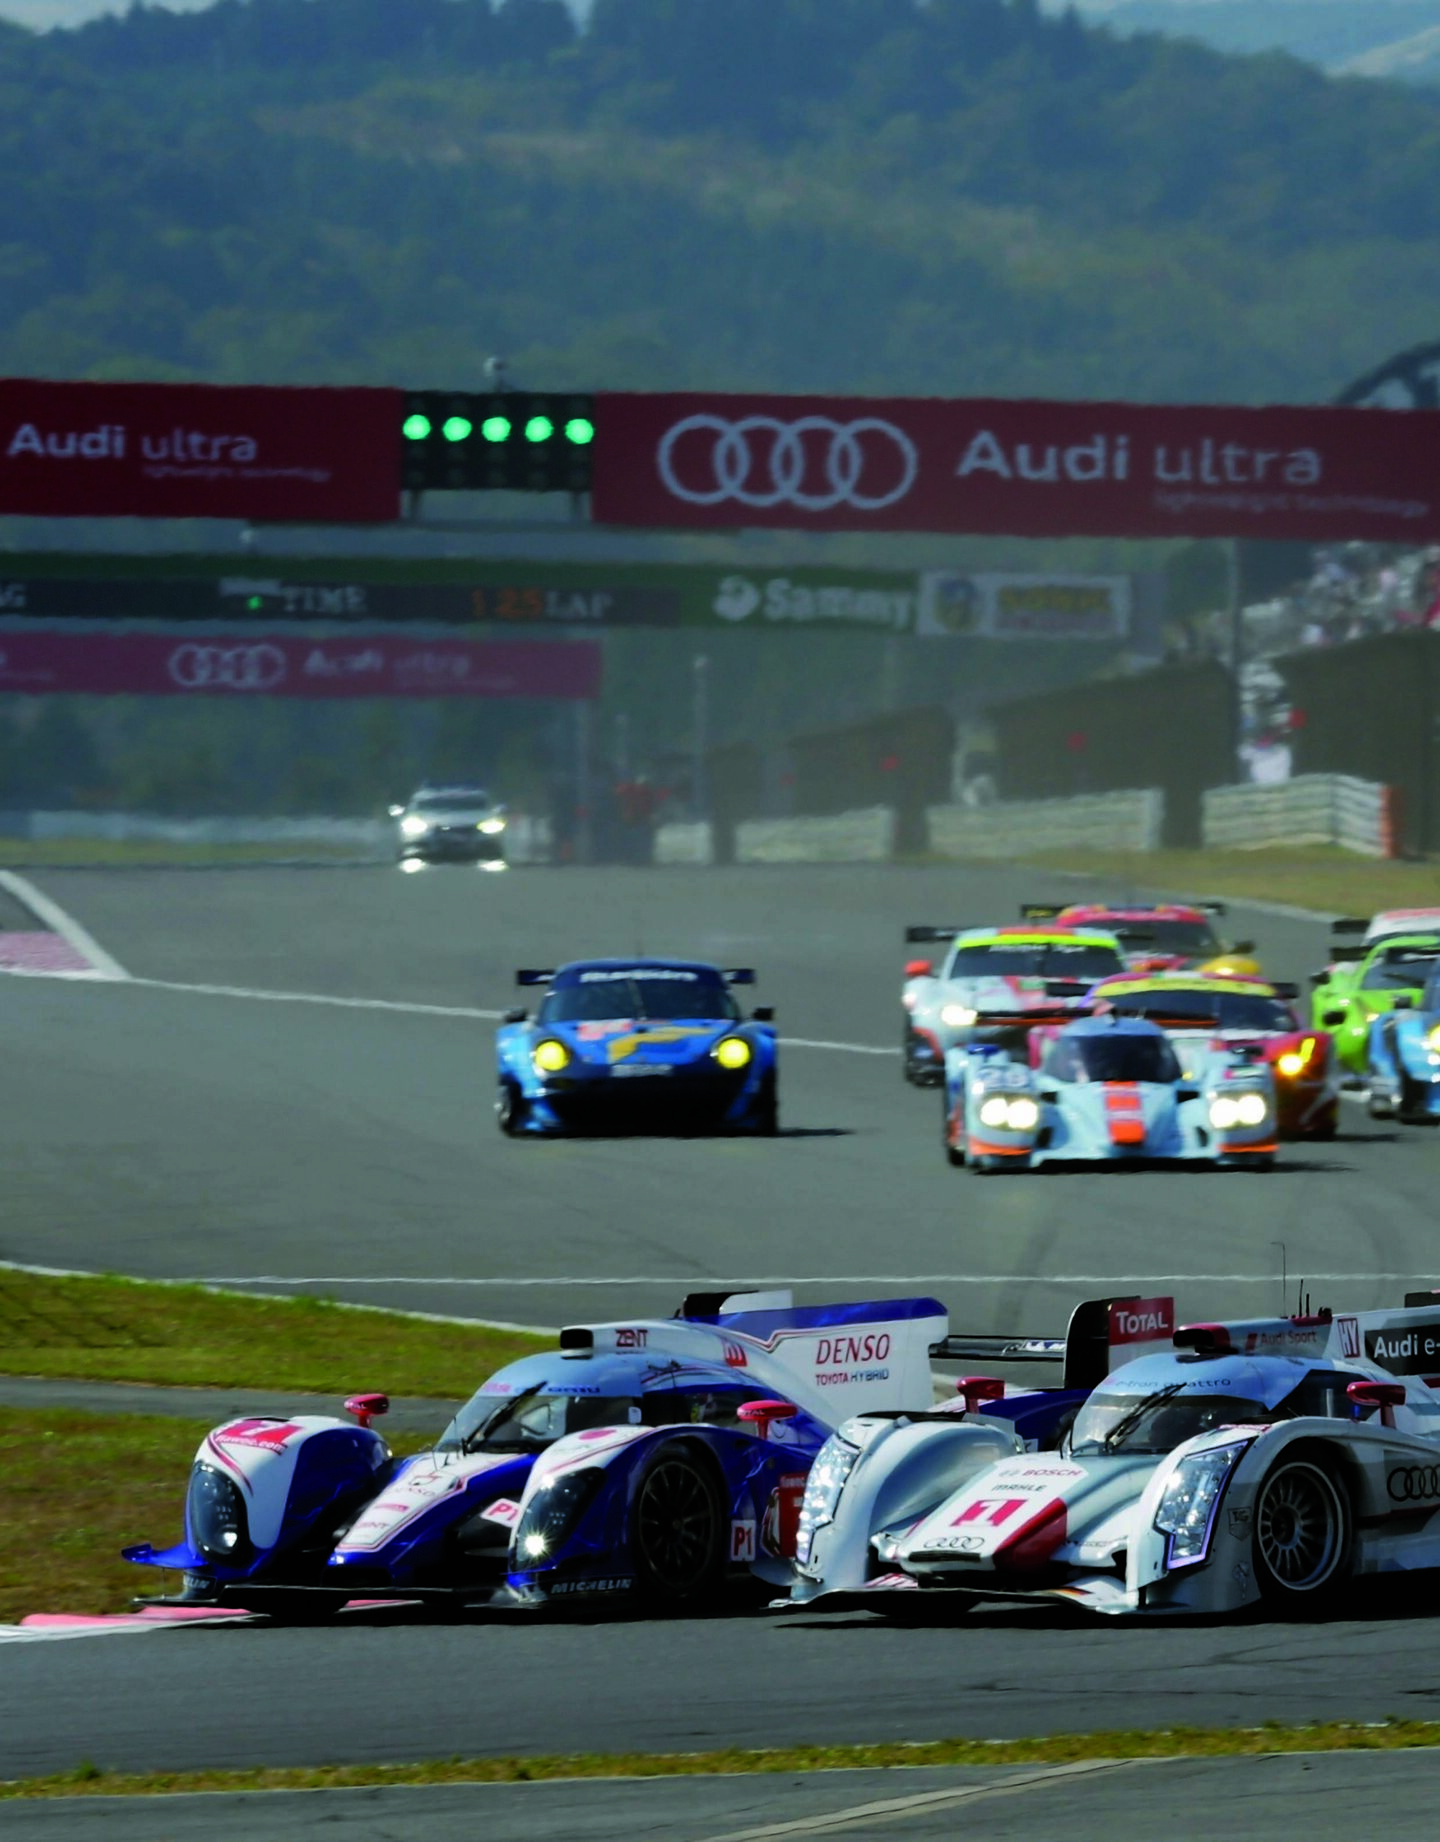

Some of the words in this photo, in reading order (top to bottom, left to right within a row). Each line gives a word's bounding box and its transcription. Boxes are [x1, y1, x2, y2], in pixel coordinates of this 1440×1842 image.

[8, 423, 126, 459] Audi
[141, 427, 258, 461] ultra
[956, 429, 1129, 480] Audi
[1154, 437, 1322, 484] ultra
[1116, 1310, 1169, 1334] TOTAL
[614, 1329, 649, 1348] ZENT
[815, 1333, 890, 1365] DENSO
[1260, 1331, 1286, 1345] Audi
[1287, 1330, 1318, 1346] Sport
[1373, 1334, 1419, 1359] Audi
[815, 1372, 849, 1386] TOYOTA
[850, 1367, 890, 1383] HYBRID
[1021, 1469, 1084, 1477] BOSCH
[489, 1502, 518, 1521] P1
[958, 1501, 1000, 1526] 1
[734, 1526, 752, 1557] P1
[550, 1578, 633, 1594] MICHELIN
